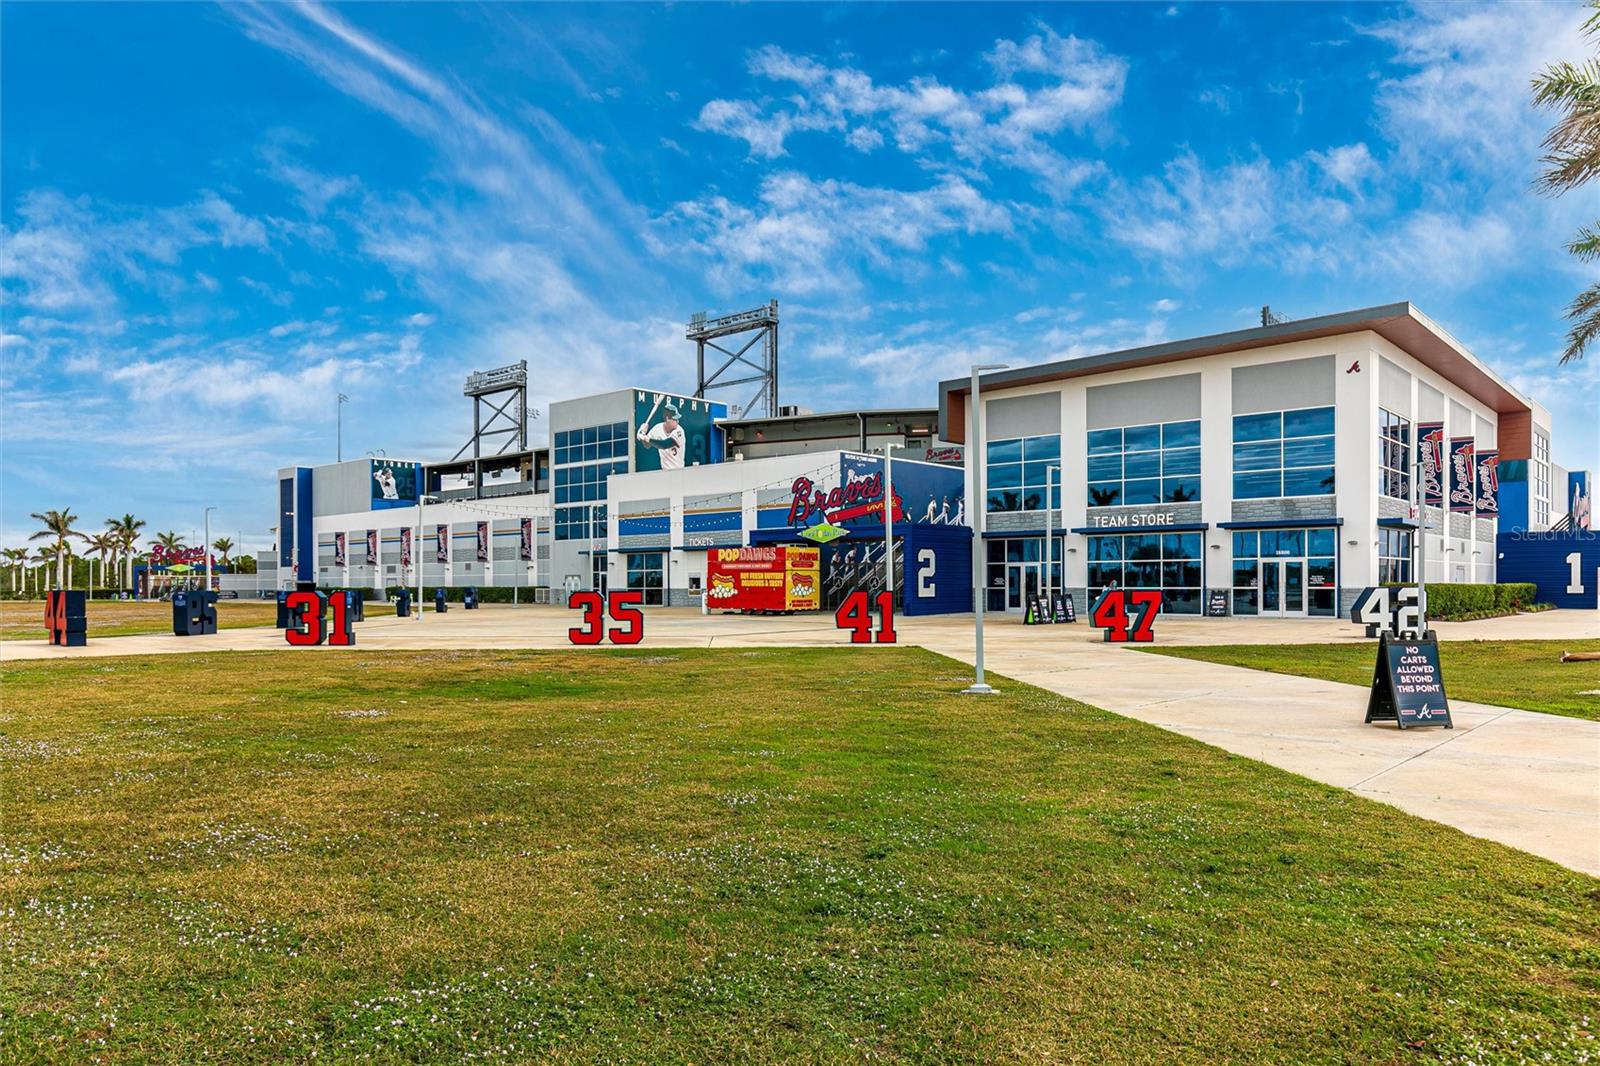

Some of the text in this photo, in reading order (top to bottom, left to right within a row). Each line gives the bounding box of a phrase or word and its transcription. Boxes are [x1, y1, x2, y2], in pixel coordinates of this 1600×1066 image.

[1417, 441, 1442, 497] Braves
[1451, 454, 1474, 505] Braves
[1476, 466, 1499, 512] Braves
[787, 471, 883, 527] Braves
[1094, 513, 1175, 528] TEAM STORE
[689, 537, 714, 546] TICKETS
[718, 548, 776, 562] POPDAWGS
[917, 549, 936, 598] 2
[1566, 552, 1585, 594] 1
[44, 591, 67, 646] 44
[286, 591, 350, 646] 31
[568, 591, 644, 645] 35
[835, 591, 897, 643] 41
[1093, 590, 1163, 642] 47
[1360, 587, 1427, 640] 42
[1396, 665, 1435, 674] ALLOWED
[1400, 656, 1428, 664] CARTS
[1405, 646, 1419, 654] NO
[1396, 684, 1440, 693] THIS POINT
[1400, 675, 1433, 684] BEYOND
